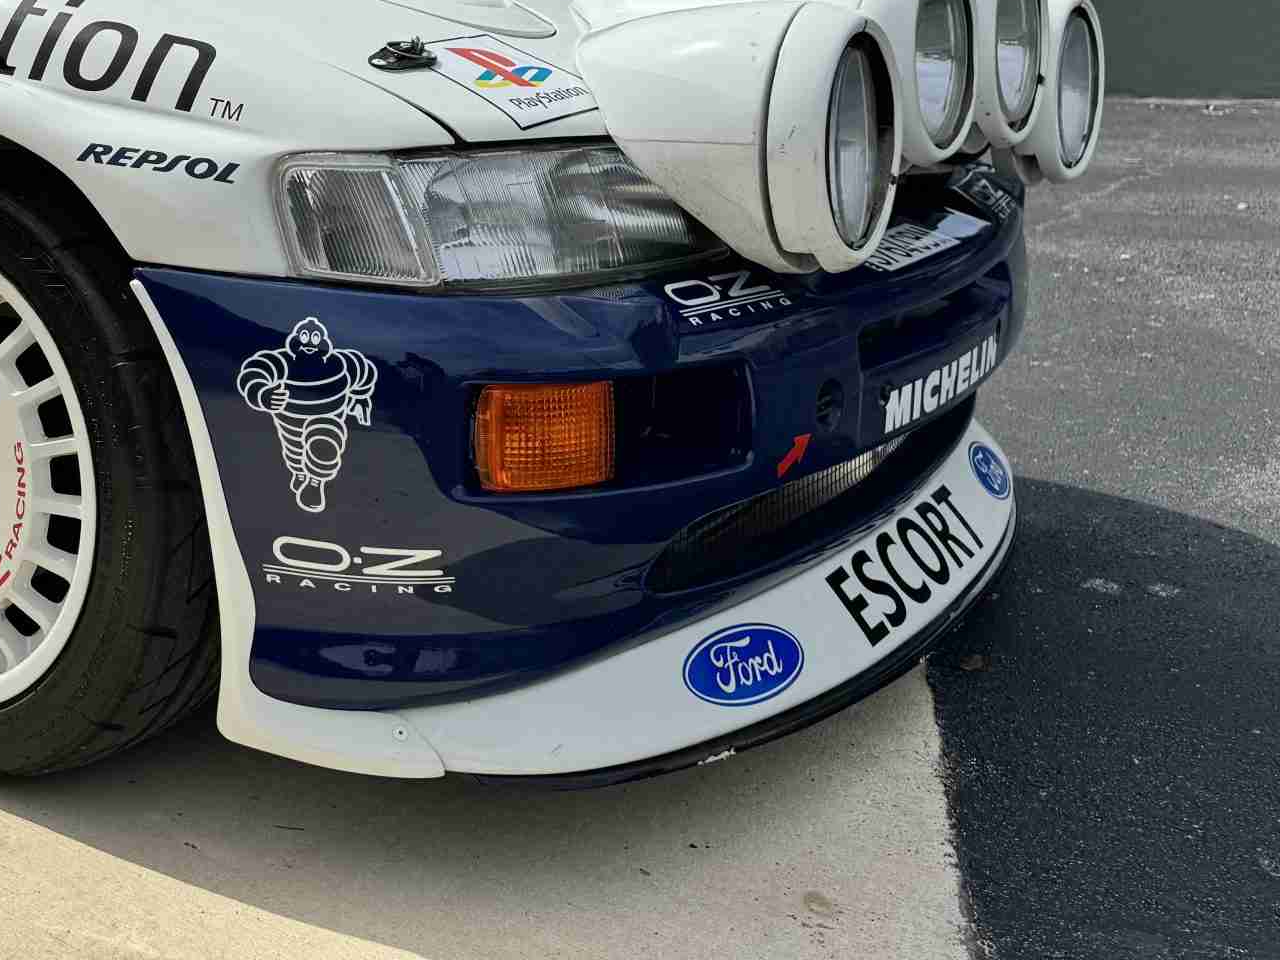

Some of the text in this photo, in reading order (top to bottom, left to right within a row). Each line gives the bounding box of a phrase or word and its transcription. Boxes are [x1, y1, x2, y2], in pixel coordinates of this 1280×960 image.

[508, 85, 590, 111] PlayStation
[76, 142, 242, 184] REPSOL
[688, 297, 792, 327] RACING
[884, 334, 998, 435] MICHELIN
[5, 441, 29, 560] RACING
[266, 573, 456, 594] RACING
[825, 483, 985, 647] ESCORT
[711, 637, 785, 693] Ford
